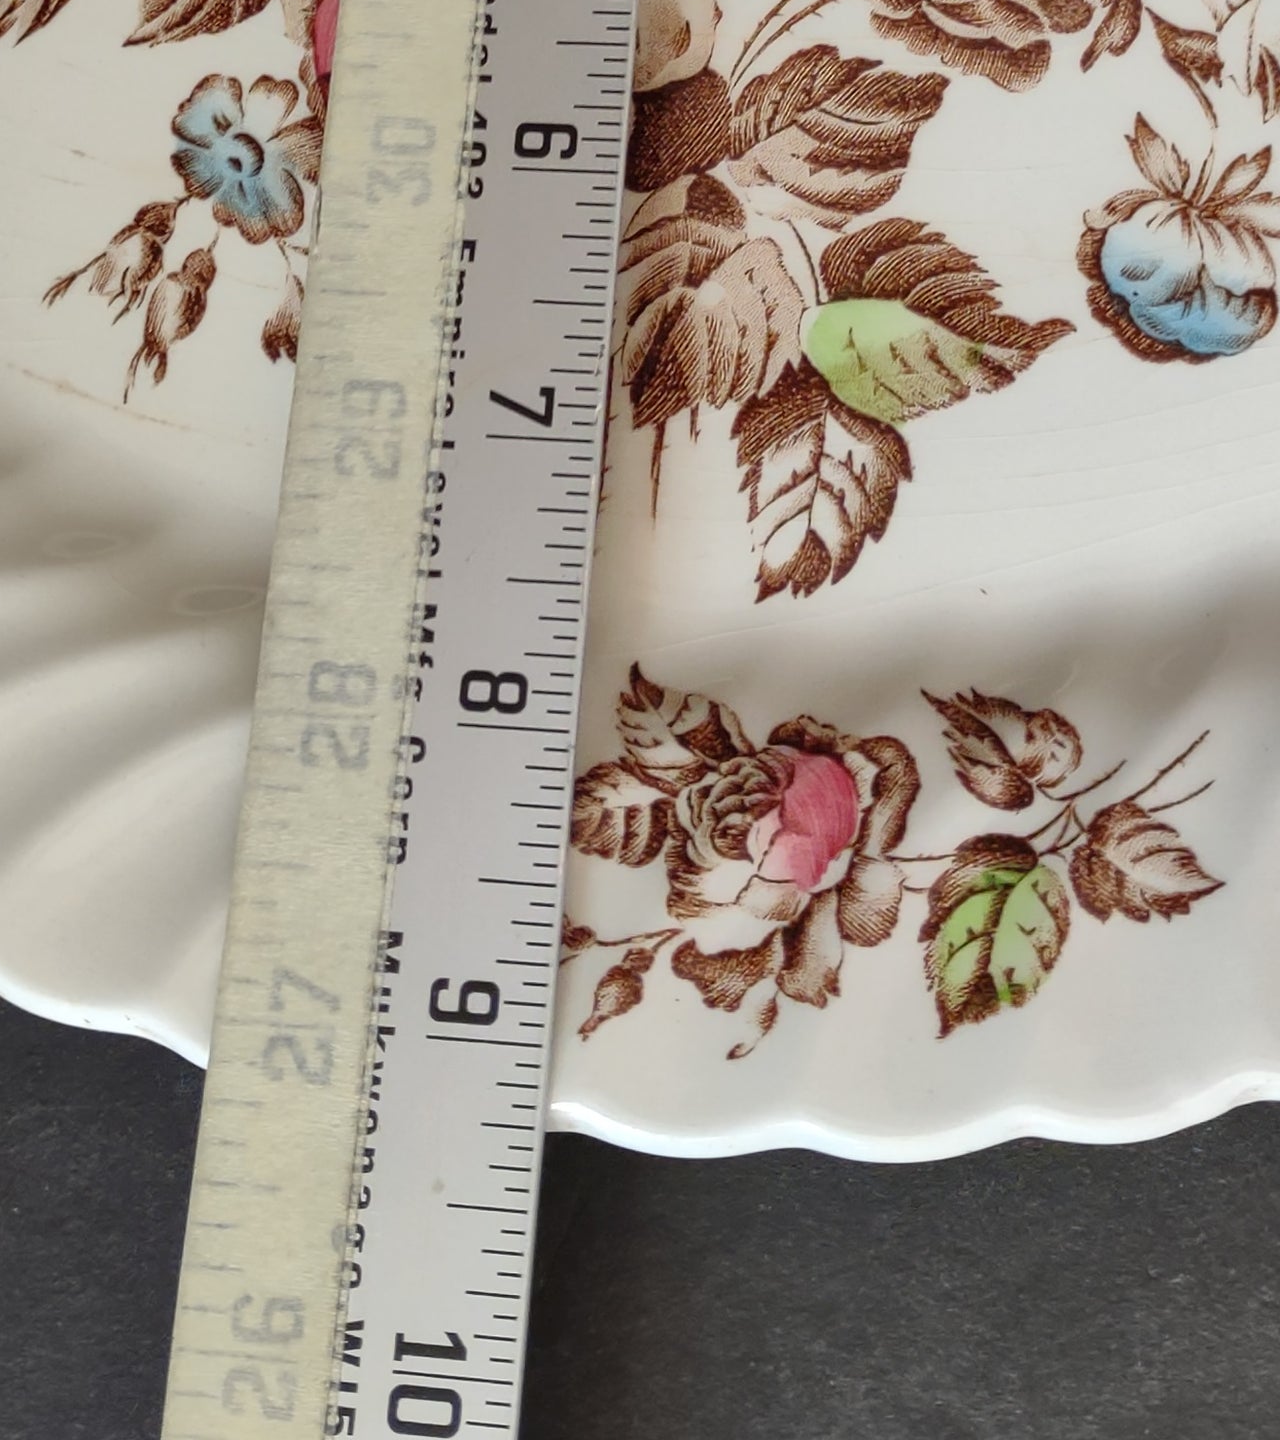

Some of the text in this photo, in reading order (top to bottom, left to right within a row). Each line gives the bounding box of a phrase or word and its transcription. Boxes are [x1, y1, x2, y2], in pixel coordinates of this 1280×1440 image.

[365, 115, 437, 206] 30
[514, 122, 579, 160] 6
[489, 386, 555, 428] 7
[301, 660, 377, 771] 28
[459, 670, 529, 714] 8
[262, 966, 341, 1086] 27
[429, 977, 501, 1026] 9
[223, 1293, 306, 1422] 26
[387, 1331, 468, 1439] 10
